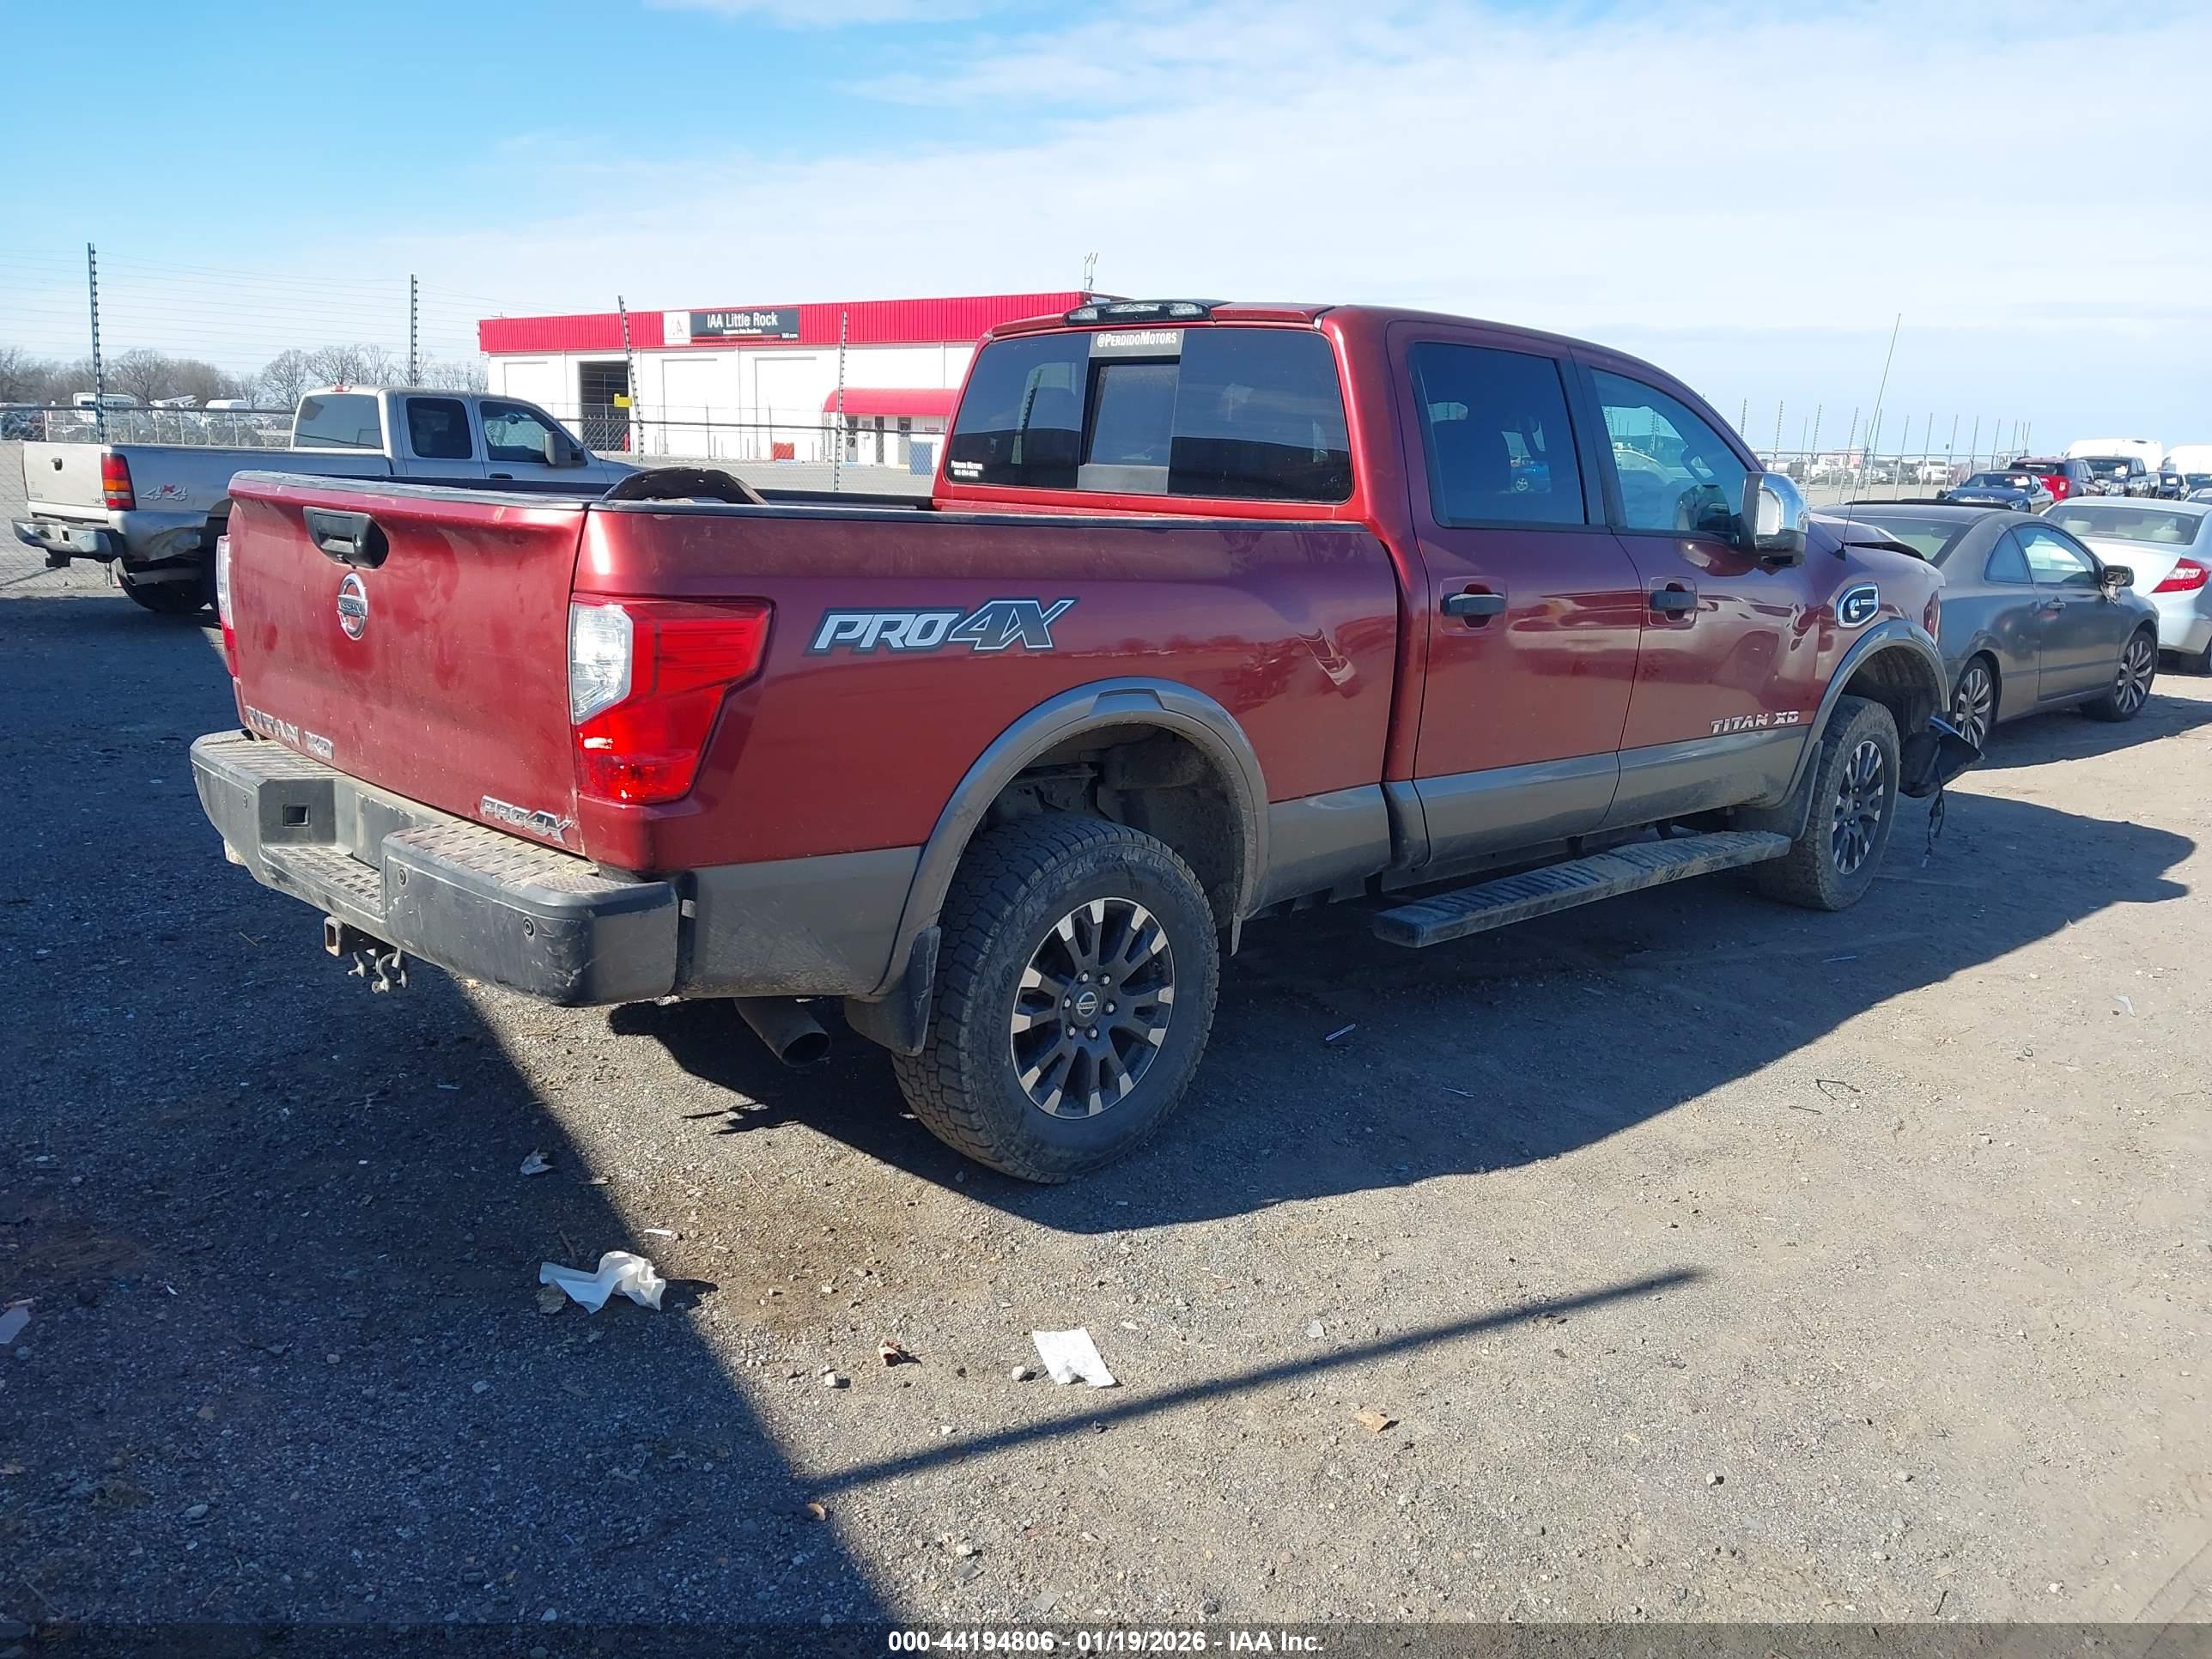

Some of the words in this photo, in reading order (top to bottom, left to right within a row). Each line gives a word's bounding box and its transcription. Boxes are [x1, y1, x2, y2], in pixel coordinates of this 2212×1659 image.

[707, 314, 723, 328] IAA
[726, 313, 750, 327] Little
[753, 312, 778, 326] Rock
[244, 705, 301, 746] TITAN
[1711, 714, 1769, 733] TITAN
[1773, 711, 1799, 725] XD
